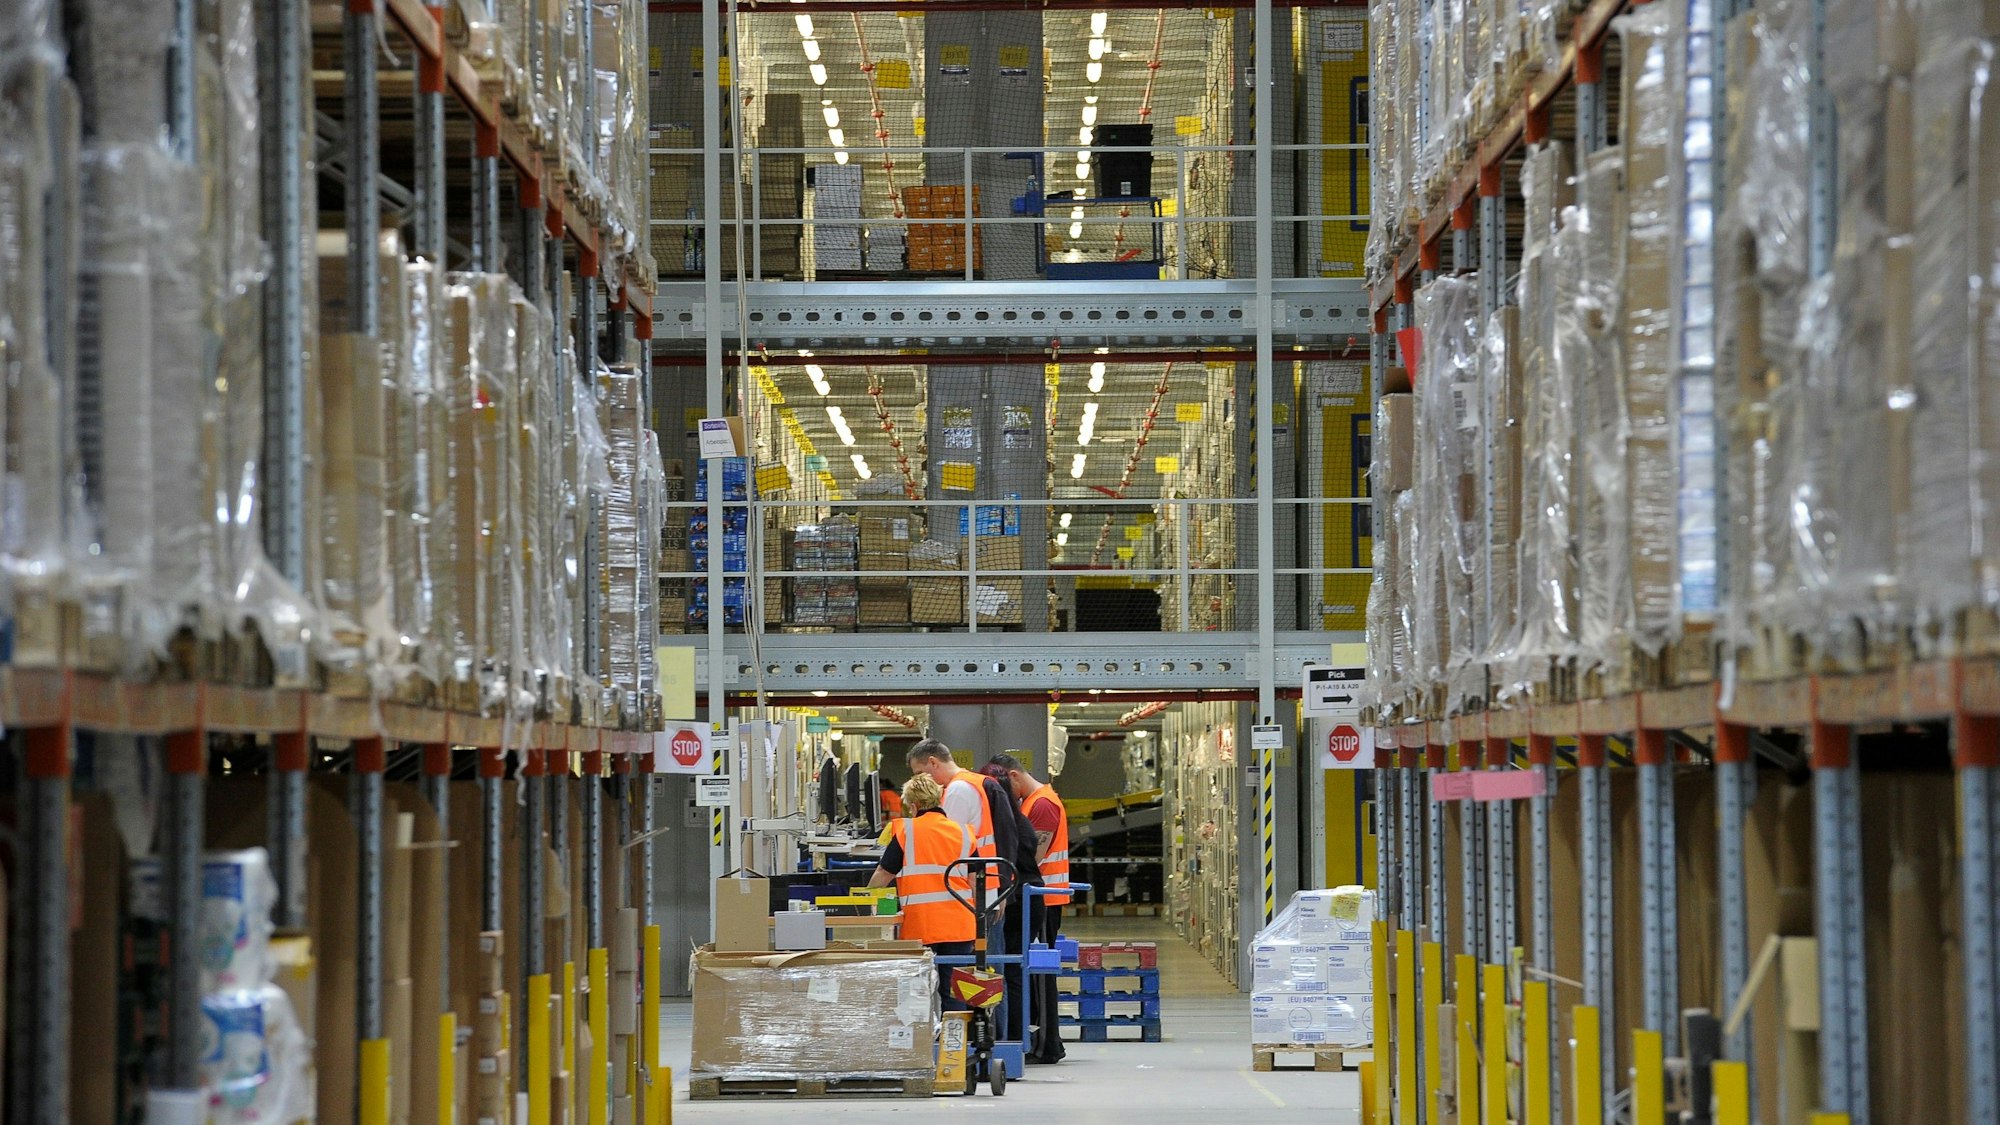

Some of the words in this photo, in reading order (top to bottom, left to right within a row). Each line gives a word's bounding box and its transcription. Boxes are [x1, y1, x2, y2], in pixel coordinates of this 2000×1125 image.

[1327, 671, 1346, 679] Pick
[672, 740, 701, 756] STOP
[1330, 736, 1359, 752] STOP
